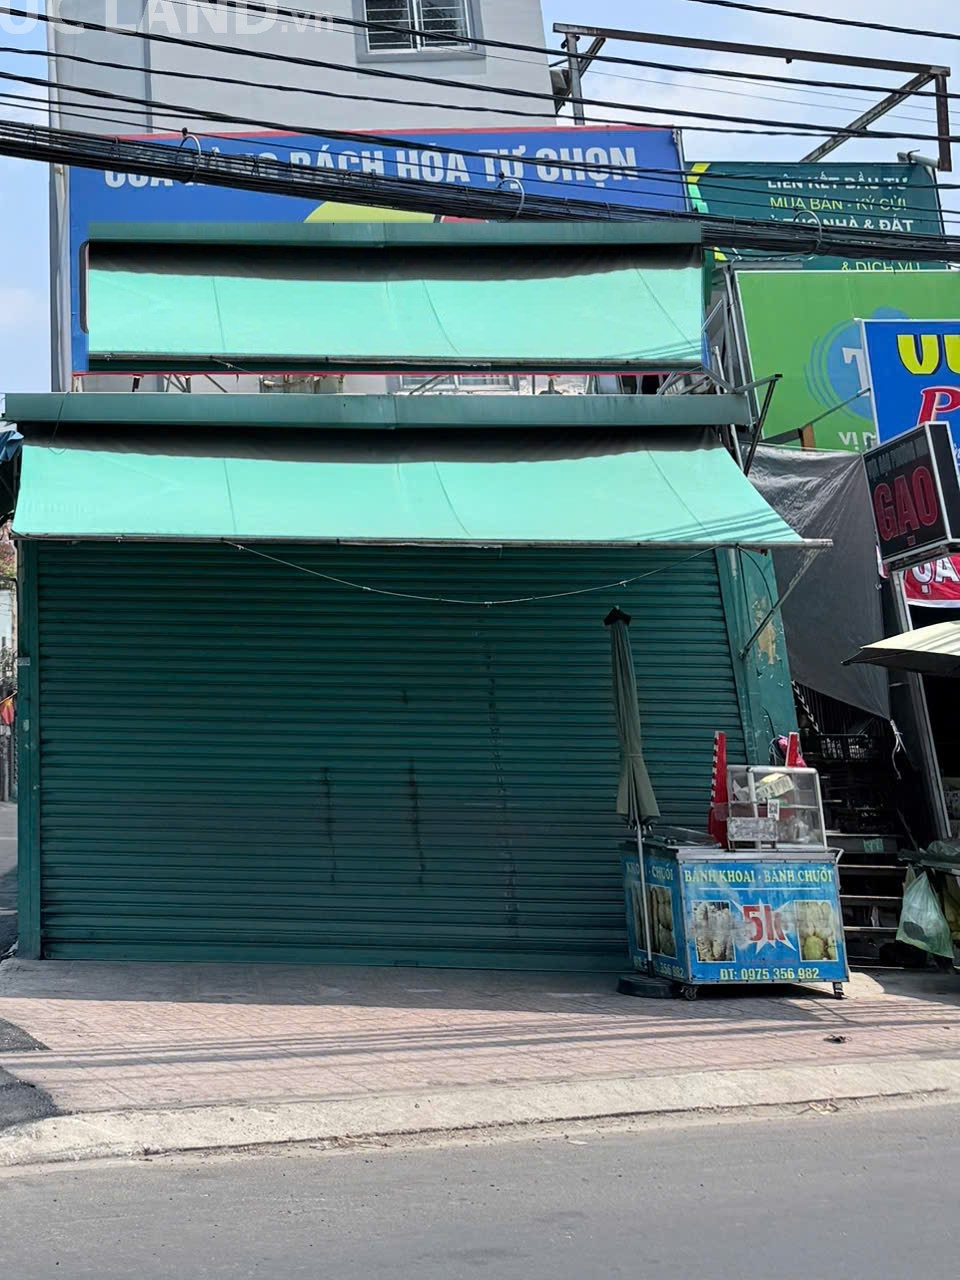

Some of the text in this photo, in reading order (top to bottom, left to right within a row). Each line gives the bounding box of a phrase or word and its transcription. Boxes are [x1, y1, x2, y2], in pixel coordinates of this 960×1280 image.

[535, 147, 640, 187] CHỌN
[770, 196, 806, 210] MUA
[810, 194, 843, 210] BÁN
[879, 214, 913, 232] ĐẤT
[873, 465, 939, 546] GẠO
[741, 968, 770, 980] 0975
[773, 967, 795, 979] 356
[798, 967, 820, 979] 982
